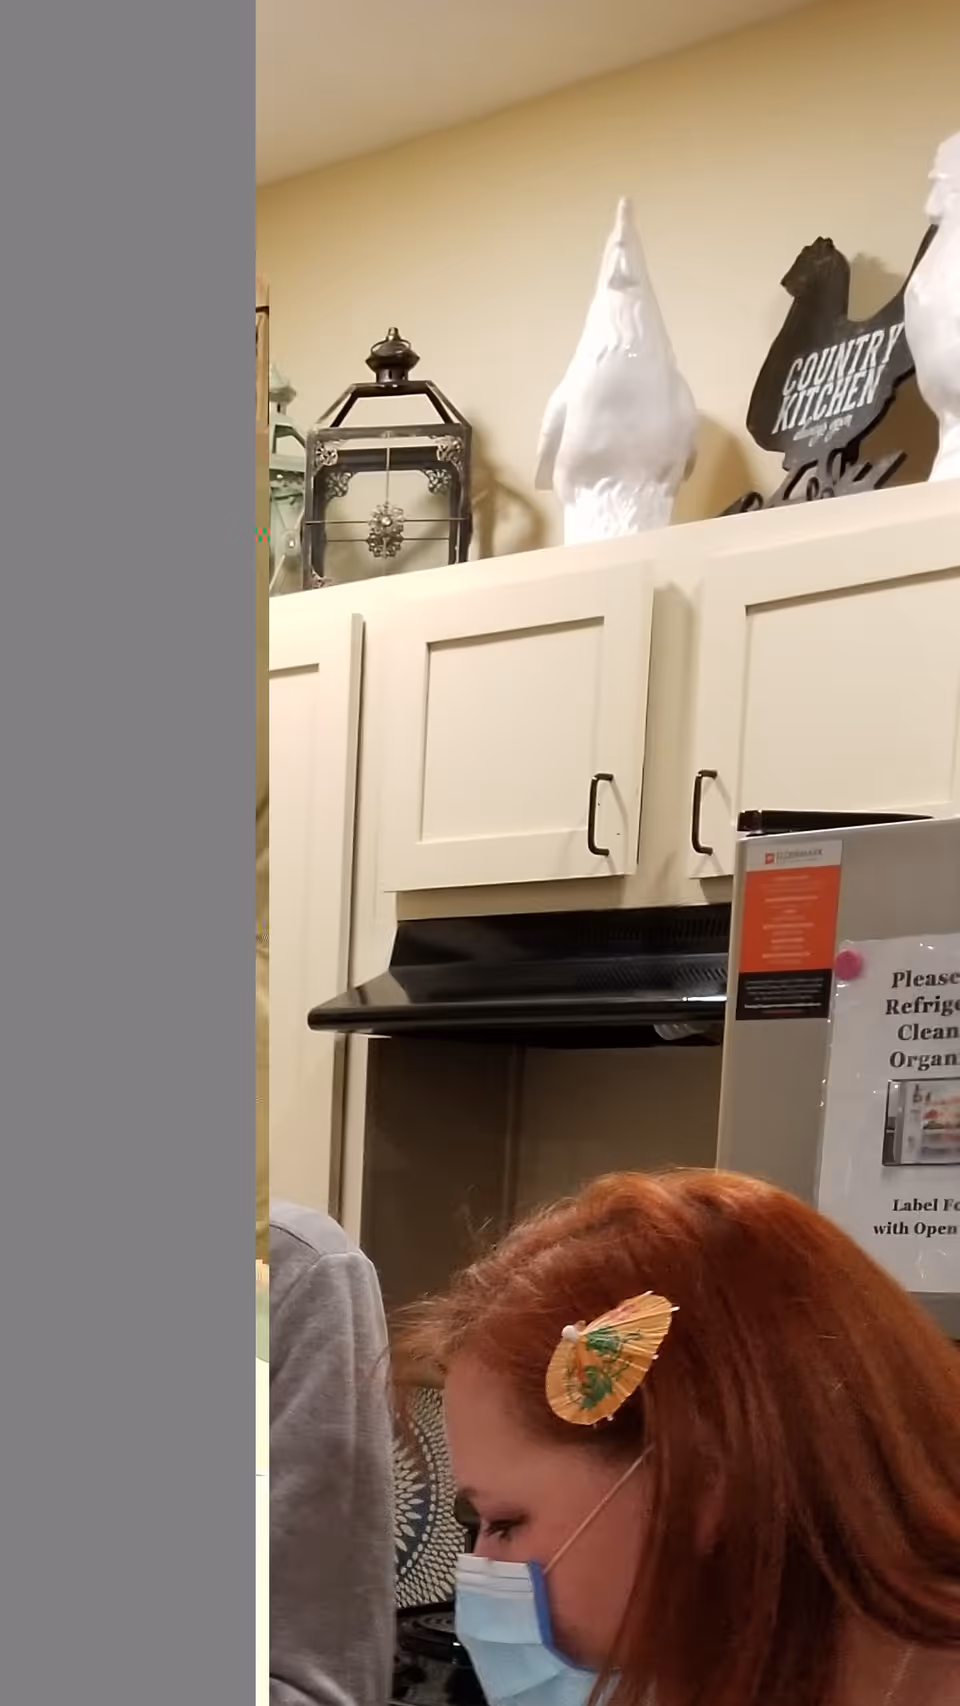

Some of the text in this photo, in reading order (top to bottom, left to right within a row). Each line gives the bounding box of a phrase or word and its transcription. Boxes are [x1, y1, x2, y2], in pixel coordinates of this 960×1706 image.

[783, 321, 905, 396] COUNTRY
[771, 364, 886, 435] KITCHEN
[891, 969, 960, 988] Please
[897, 1023, 959, 1041] Clean
[889, 1050, 960, 1071] Organ
[892, 1198, 938, 1212] Label
[873, 1221, 958, 1238] with Open
